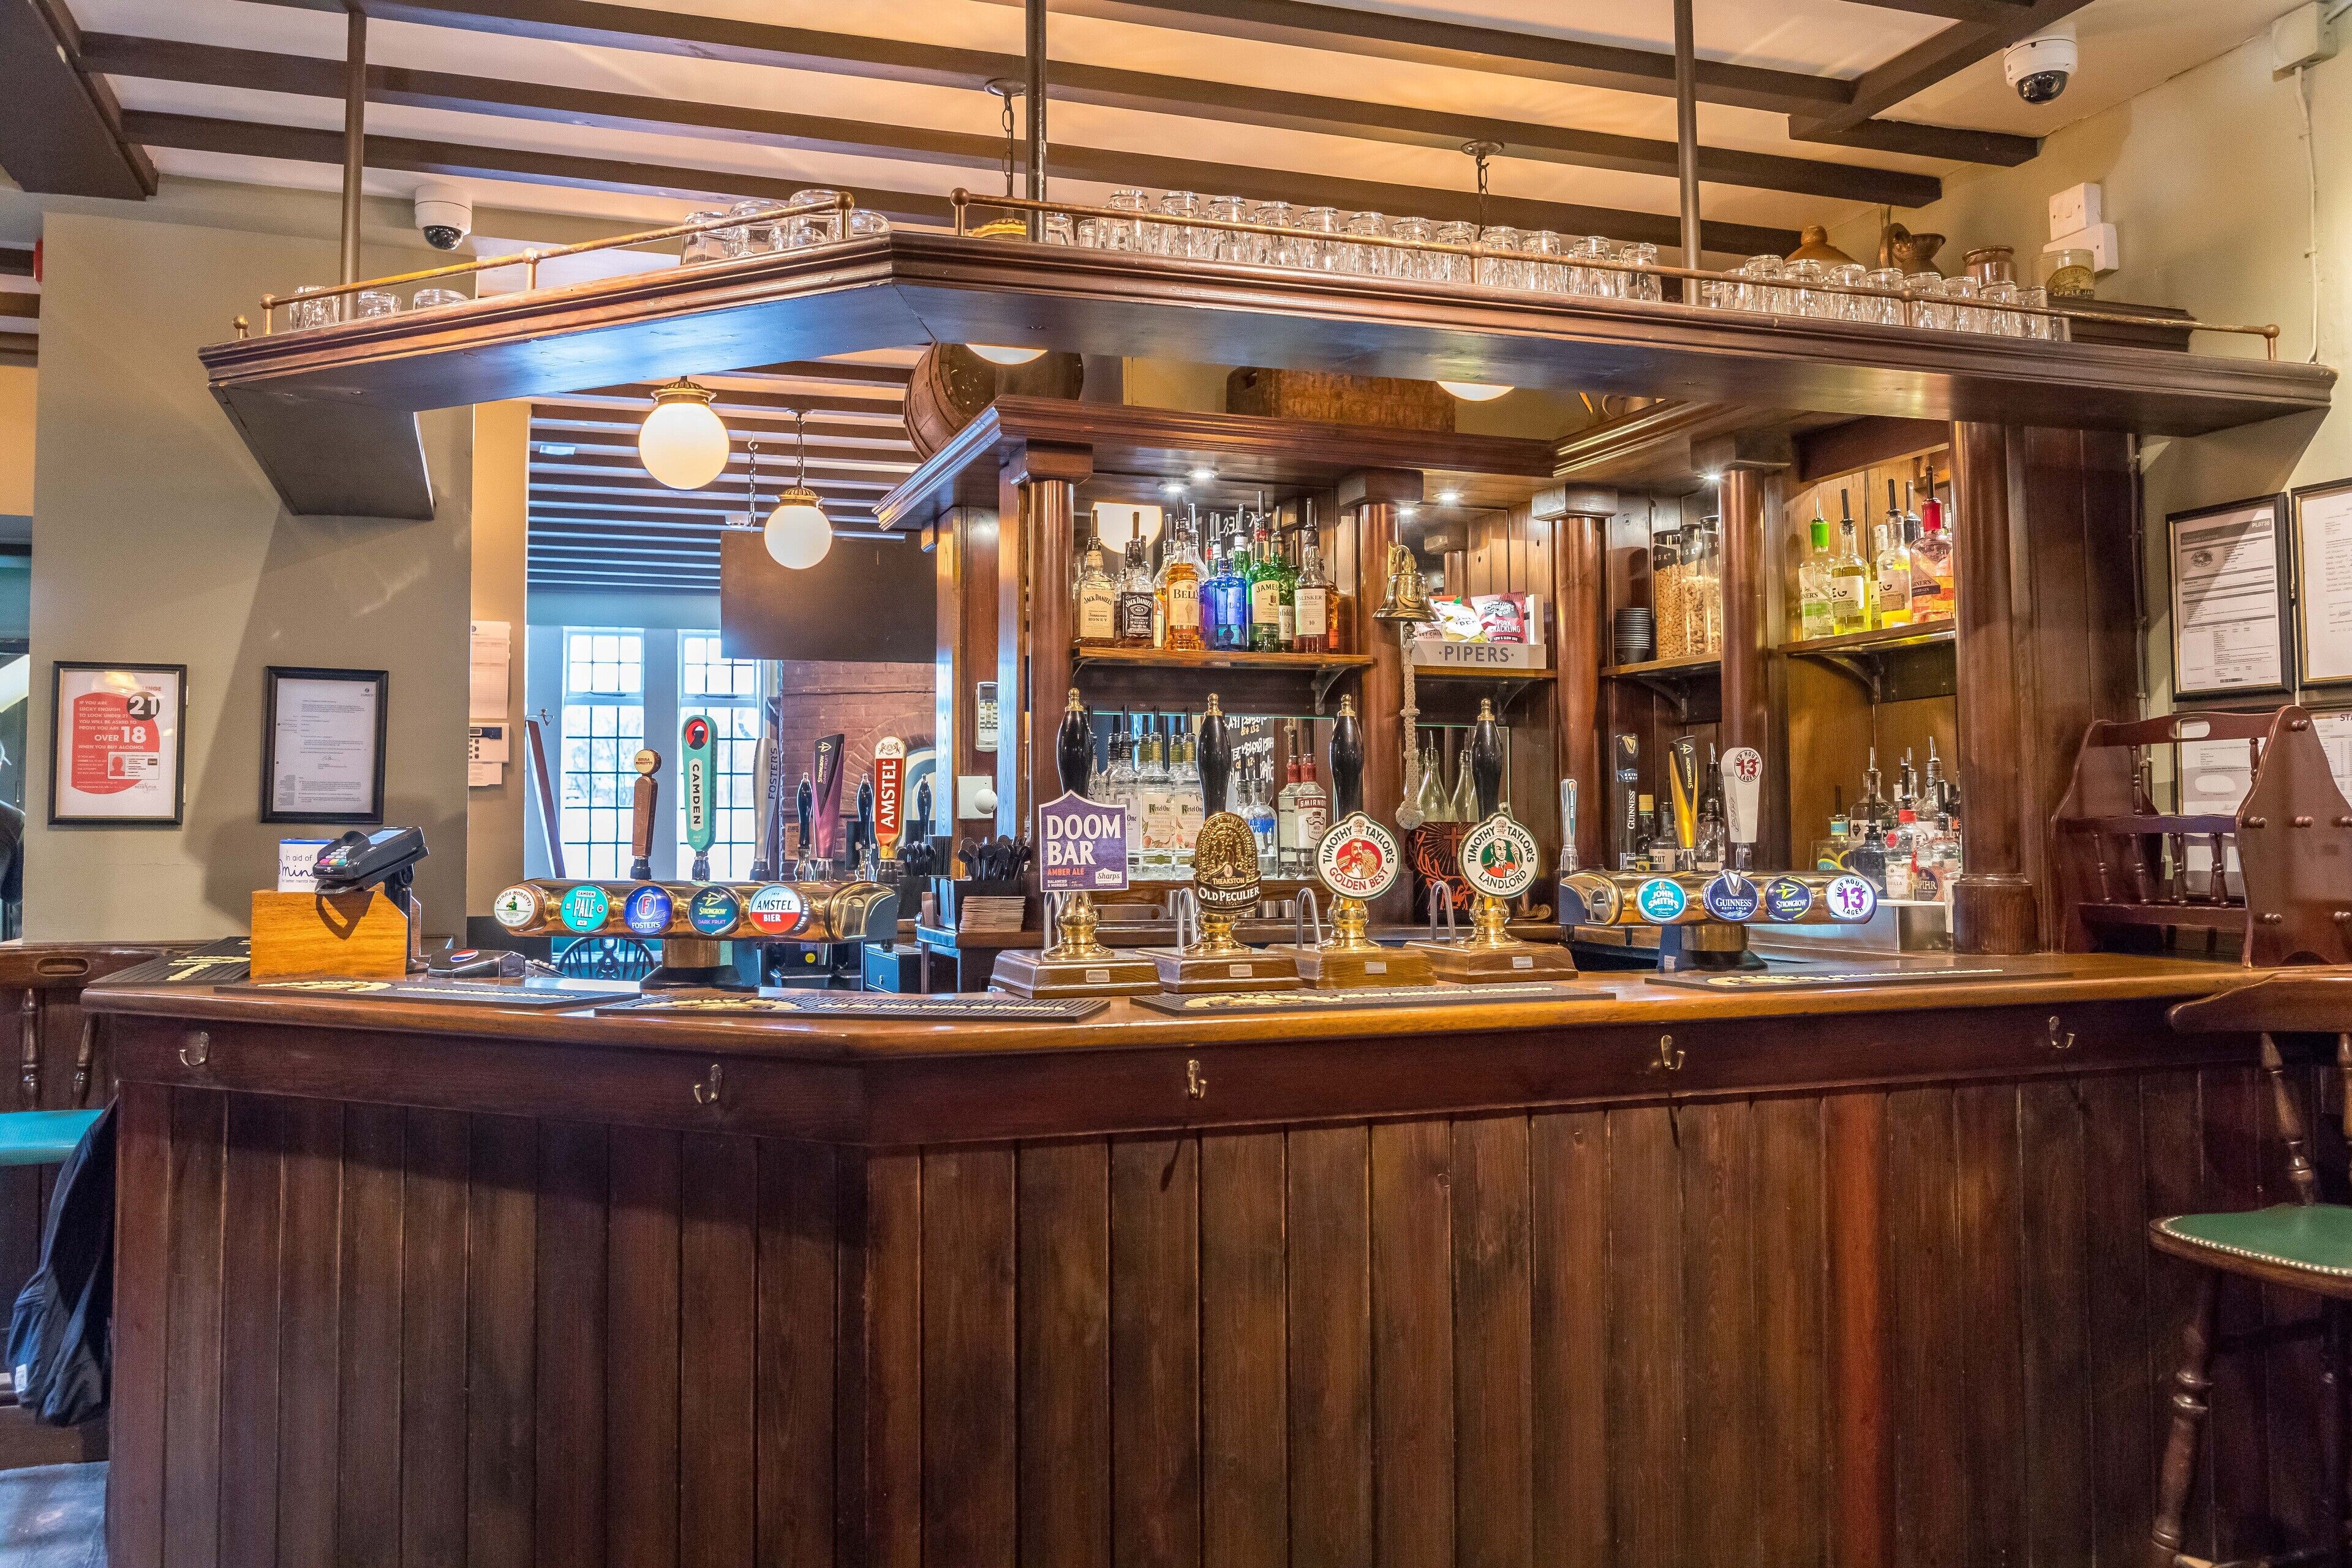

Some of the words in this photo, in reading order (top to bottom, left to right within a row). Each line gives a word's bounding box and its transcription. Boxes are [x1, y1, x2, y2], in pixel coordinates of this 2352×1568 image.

[1084, 595, 1095, 605] JACK
[1125, 597, 1136, 608] JACK
[1489, 625, 1521, 634] CRACKLING
[1444, 645, 1509, 663] PIPERS
[129, 695, 157, 715] 21
[121, 726, 147, 744] 18
[1744, 752, 1760, 764] HOUSE
[768, 747, 777, 800] FOSTER'S
[1737, 759, 1758, 775] 13
[692, 764, 701, 825] CAMDEN
[881, 760, 896, 828] AMSTEL
[1627, 790, 1635, 829] GUINNESS
[1046, 814, 1121, 840] DOOM
[1323, 825, 1352, 864] TIMOTHY
[1365, 826, 1395, 864] TAYLOR'S
[1339, 834, 1368, 845] CHAMPIONSHIP
[1468, 826, 1495, 864] TIMOTHY
[1507, 826, 1534, 863] TAYLOR'S
[1482, 834, 1509, 845] CHAMPIONSHIP
[1047, 840, 1097, 866] BAR
[1329, 867, 1366, 891] GOLDEN
[1369, 866, 1389, 888] BEST
[1478, 870, 1527, 889] LANDLORD
[1198, 886, 1218, 901] OLD
[1219, 886, 1261, 902] PECULIER
[1652, 890, 1674, 900] JOHN
[1845, 879, 1866, 895] HOUSE
[497, 892, 512, 905] BIRRA
[513, 891, 532, 907] MORETTI
[642, 897, 652, 914] F
[756, 899, 793, 911] AMSTEL
[1648, 898, 1679, 910] SMITH'S
[1716, 897, 1752, 907] GUINNESS
[1776, 899, 1807, 909] STRONGBOW
[1841, 888, 1864, 908] 13
[573, 898, 596, 919] PALE
[698, 907, 728, 916] STRONGBOW
[1842, 907, 1863, 916] LAGER
[763, 914, 782, 922] BIER
